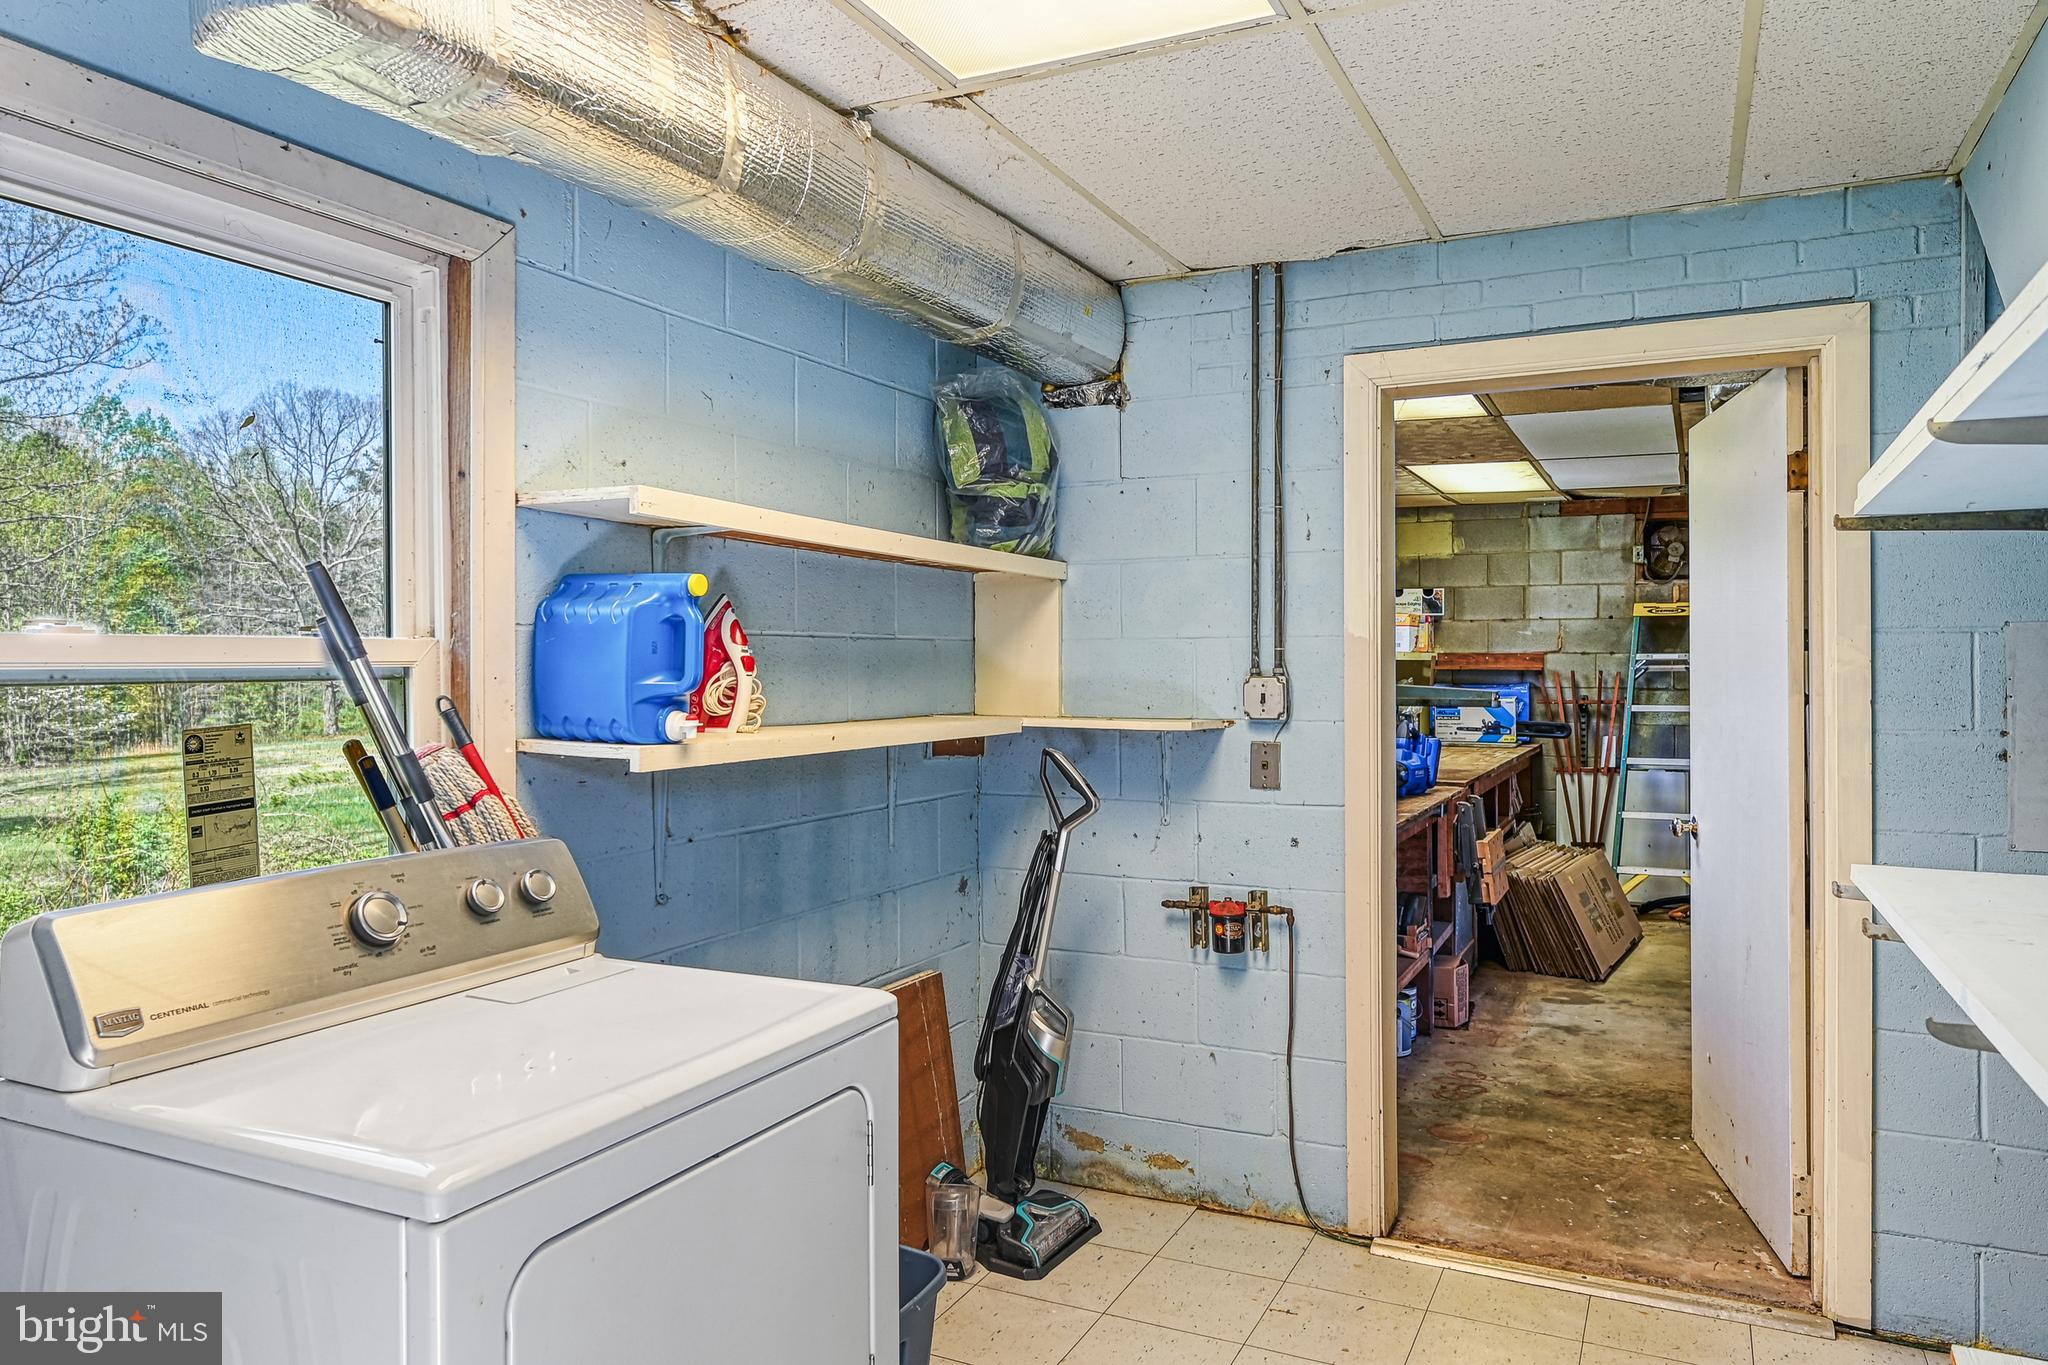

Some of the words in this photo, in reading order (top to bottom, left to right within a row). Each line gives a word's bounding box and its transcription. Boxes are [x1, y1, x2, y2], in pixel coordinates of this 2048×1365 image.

[333, 962, 359, 972] automatic
[102, 1011, 140, 1027] MAYTAG
[150, 1002, 210, 1021] CENTENNIAL
[212, 995, 242, 1007] commercial
[242, 989, 271, 1000] technology
